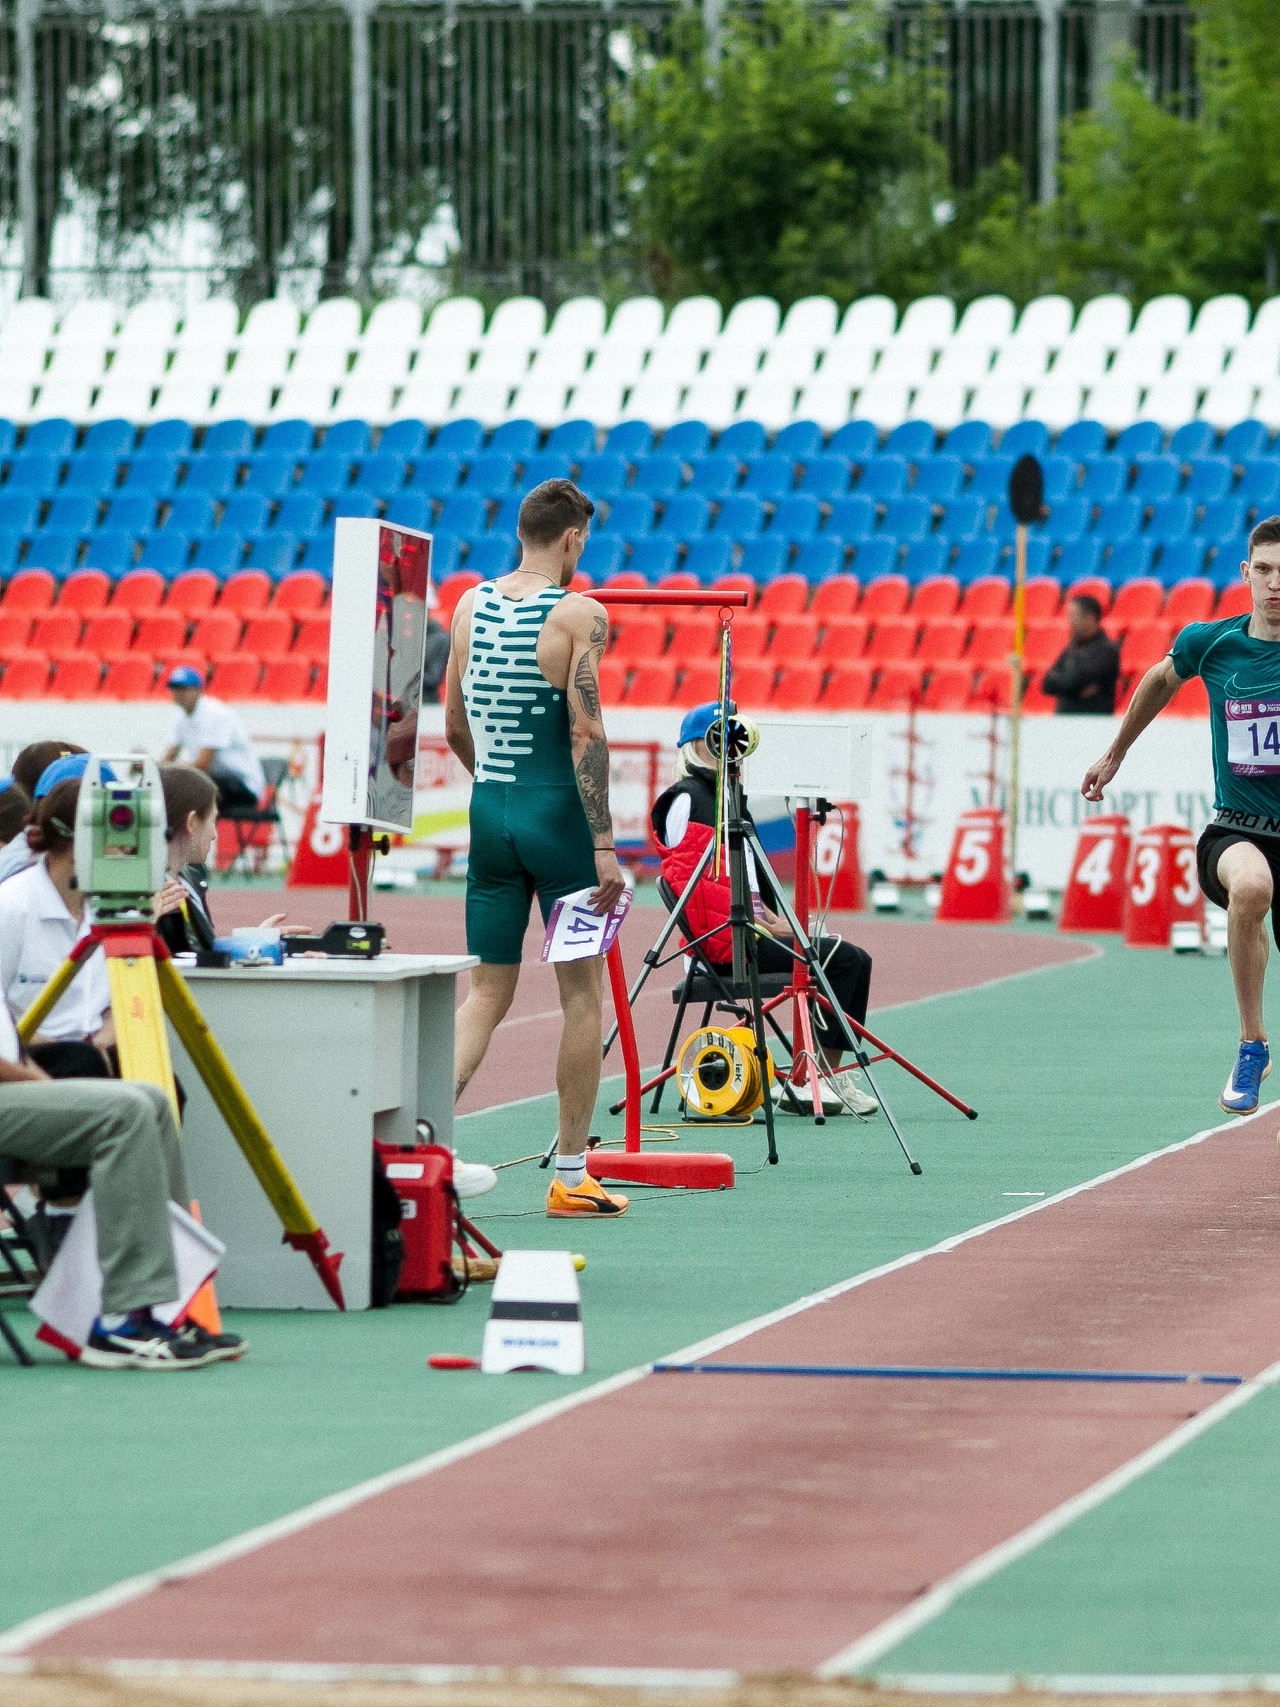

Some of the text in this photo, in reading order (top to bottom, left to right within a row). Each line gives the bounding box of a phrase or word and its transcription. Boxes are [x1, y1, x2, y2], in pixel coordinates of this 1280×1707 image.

[1218, 809, 1260, 828] PRO
[814, 823, 847, 875] 6
[954, 830, 992, 885] 5
[1076, 838, 1115, 895] 4
[1131, 849, 1198, 905] 3 3
[563, 905, 604, 946] 141
